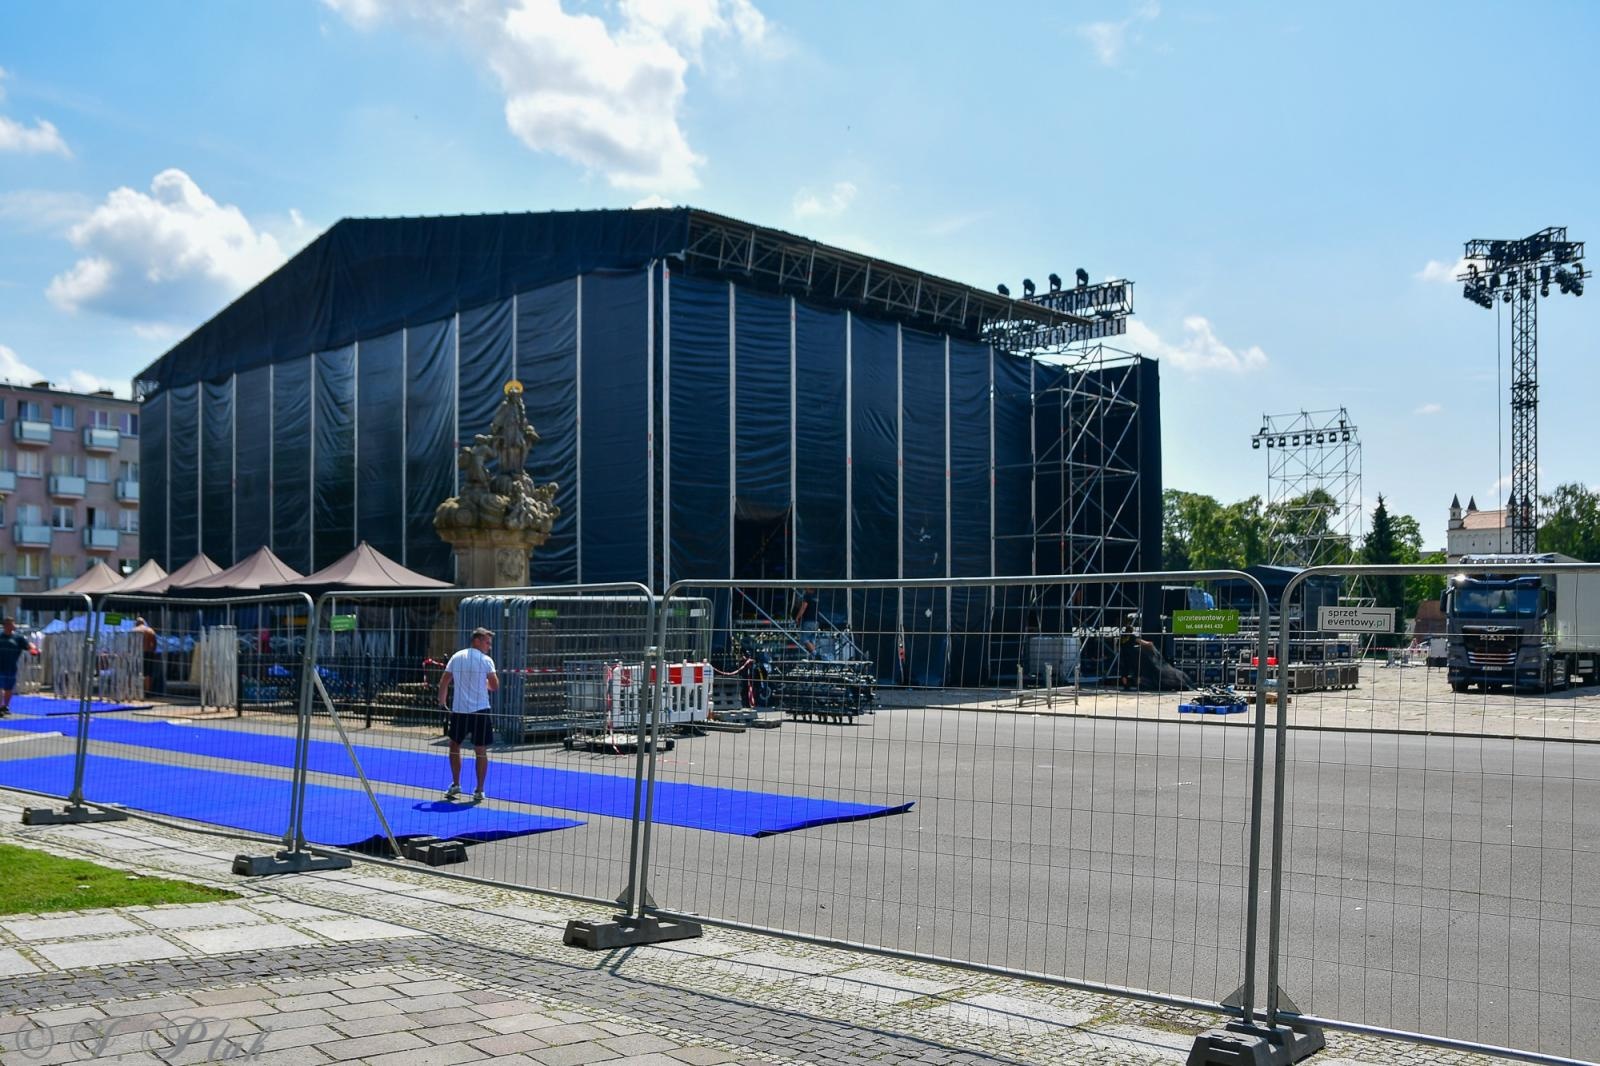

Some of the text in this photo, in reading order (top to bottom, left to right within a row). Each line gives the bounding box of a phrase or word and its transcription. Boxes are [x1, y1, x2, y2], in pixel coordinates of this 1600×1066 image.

[1177, 614, 1234, 622] sprzeteventowy.pl
[1328, 609, 1358, 618] sprzet
[1327, 618, 1386, 628] eventowy.pl
